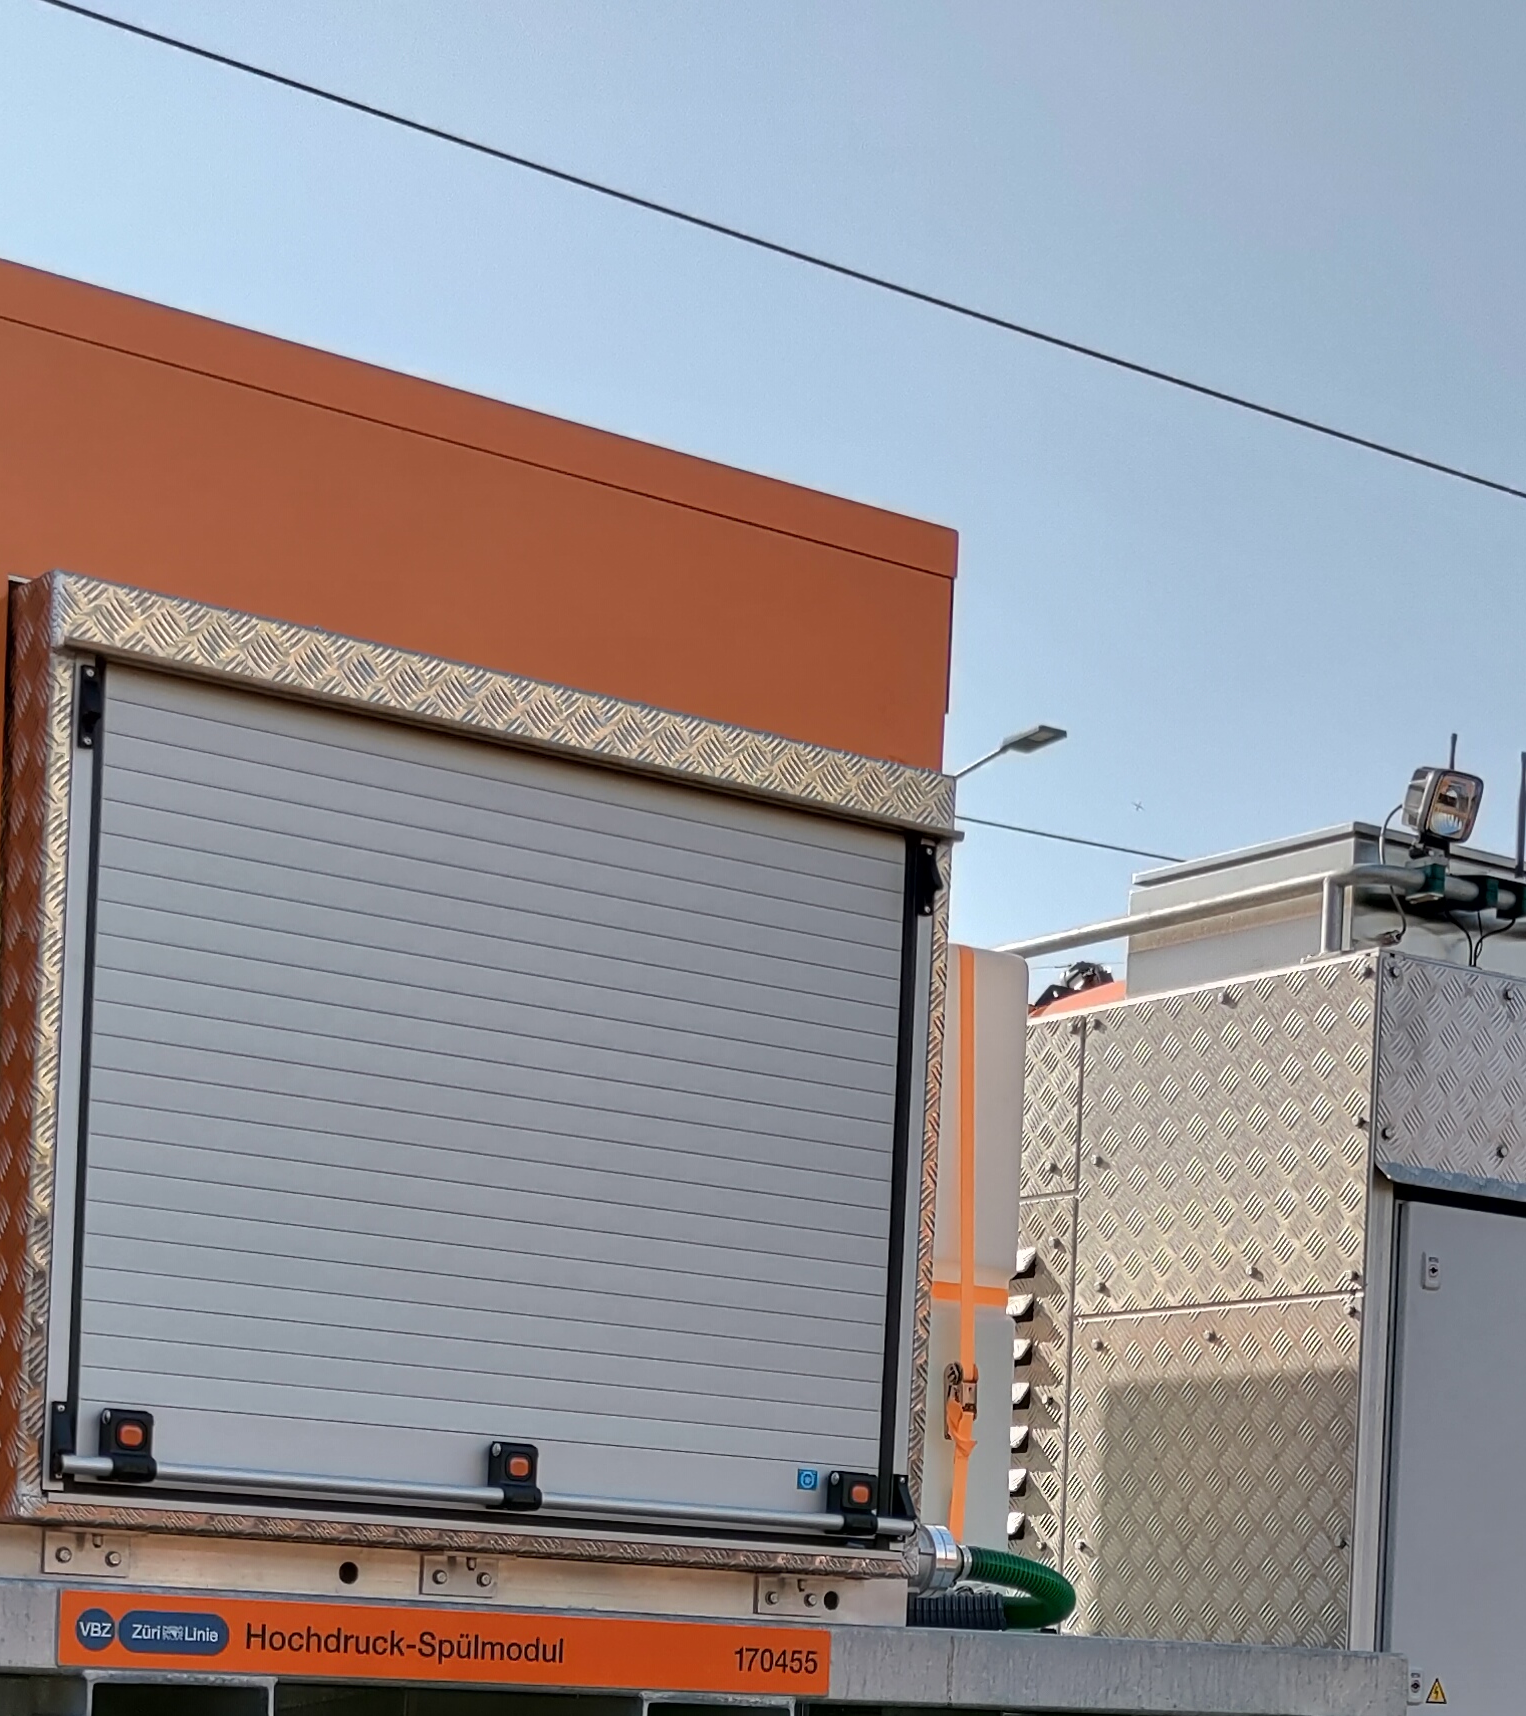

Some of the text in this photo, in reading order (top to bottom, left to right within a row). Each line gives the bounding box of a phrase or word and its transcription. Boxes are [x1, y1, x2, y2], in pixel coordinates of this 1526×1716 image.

[79, 1621, 219, 1643] VBZ Züri Linie
[245, 1622, 565, 1665] Hochdruck-Spülmodul
[734, 1646, 819, 1675] 170455
